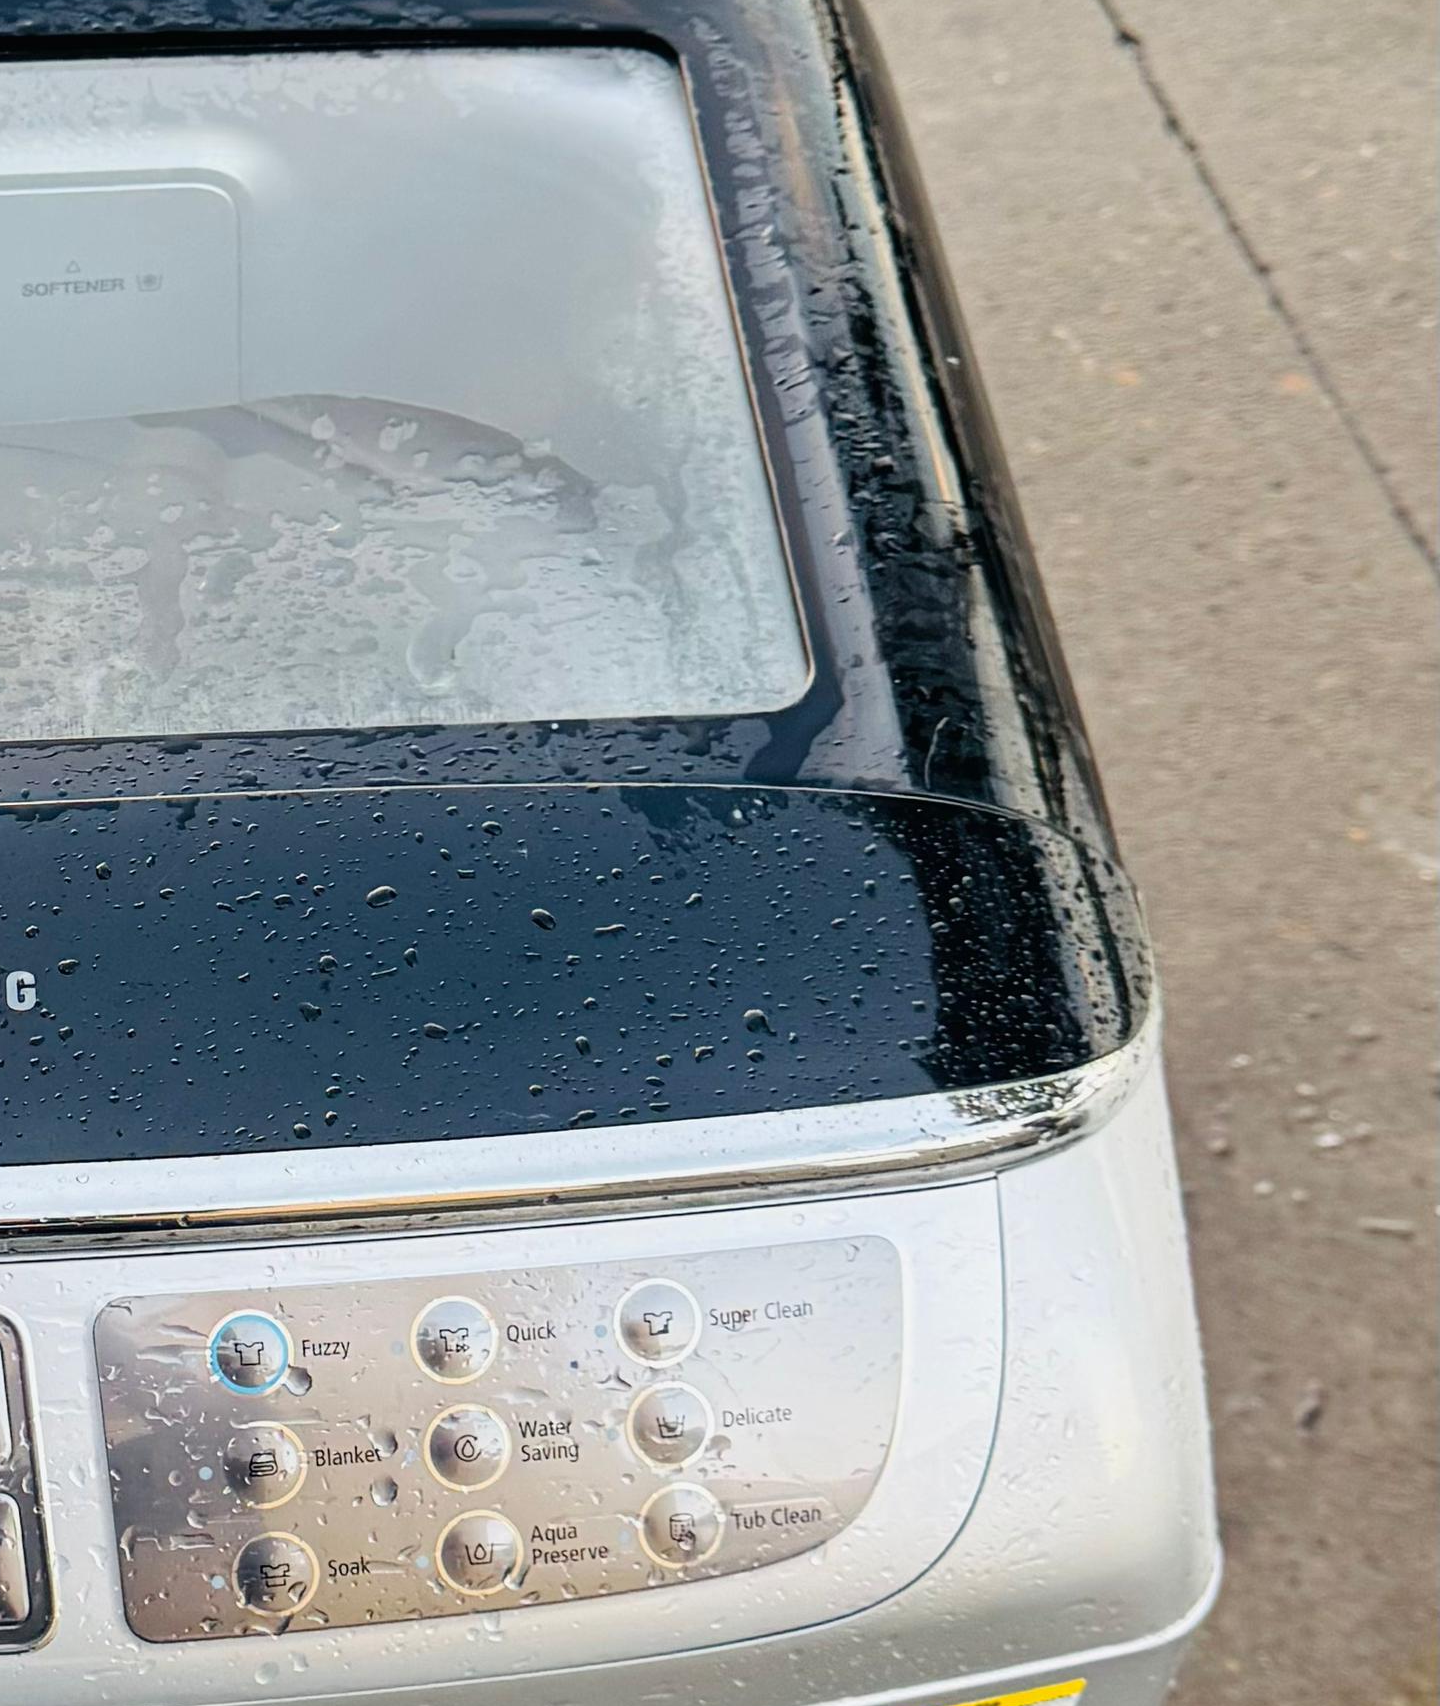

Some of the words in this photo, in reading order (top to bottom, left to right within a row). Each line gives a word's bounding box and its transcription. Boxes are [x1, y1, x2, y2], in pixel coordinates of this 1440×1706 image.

[21, 277, 125, 298] SOFTENER
[710, 1307, 757, 1330] Super
[506, 1322, 557, 1343] Quick
[302, 1339, 350, 1361] Fuzzy
[722, 1406, 793, 1428] Delicate
[518, 1420, 572, 1438] Water
[315, 1445, 383, 1467] Blanket
[520, 1442, 580, 1463] Saving
[731, 1511, 766, 1530] Tub
[770, 1507, 822, 1527] Clean
[530, 1524, 578, 1544] Aqua
[531, 1543, 609, 1565] Preserve
[327, 1556, 370, 1578] Soak
